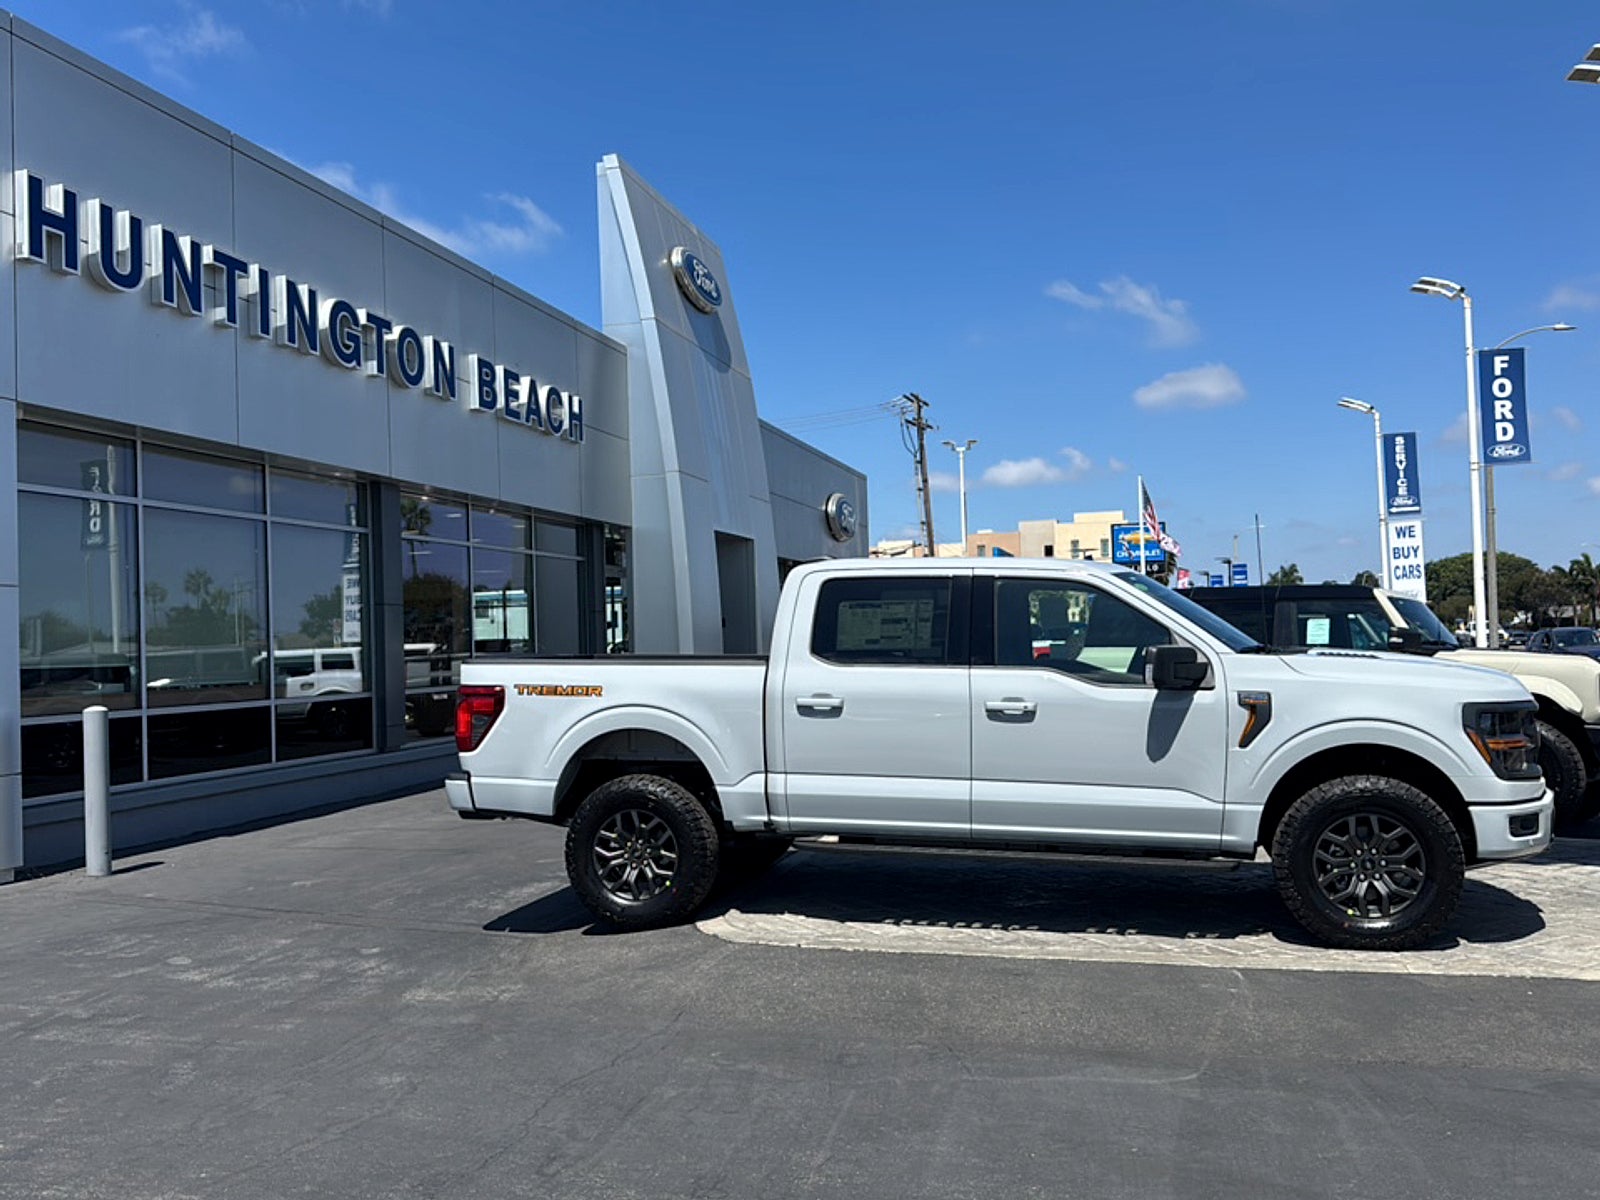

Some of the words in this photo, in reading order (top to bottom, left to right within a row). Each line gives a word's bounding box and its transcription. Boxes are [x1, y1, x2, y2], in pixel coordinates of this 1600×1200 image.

[693, 259, 718, 298] Ford
[18, 170, 457, 400] HUNTINGTON
[471, 355, 584, 443] BEACH
[1492, 355, 1514, 442] FORD
[1493, 446, 1521, 458] Ford
[1395, 436, 1408, 496] SERVICE
[1395, 525, 1416, 539] WE
[1393, 545, 1420, 559] BUY
[1394, 564, 1422, 580] CARS
[514, 684, 602, 697] TREMOR
